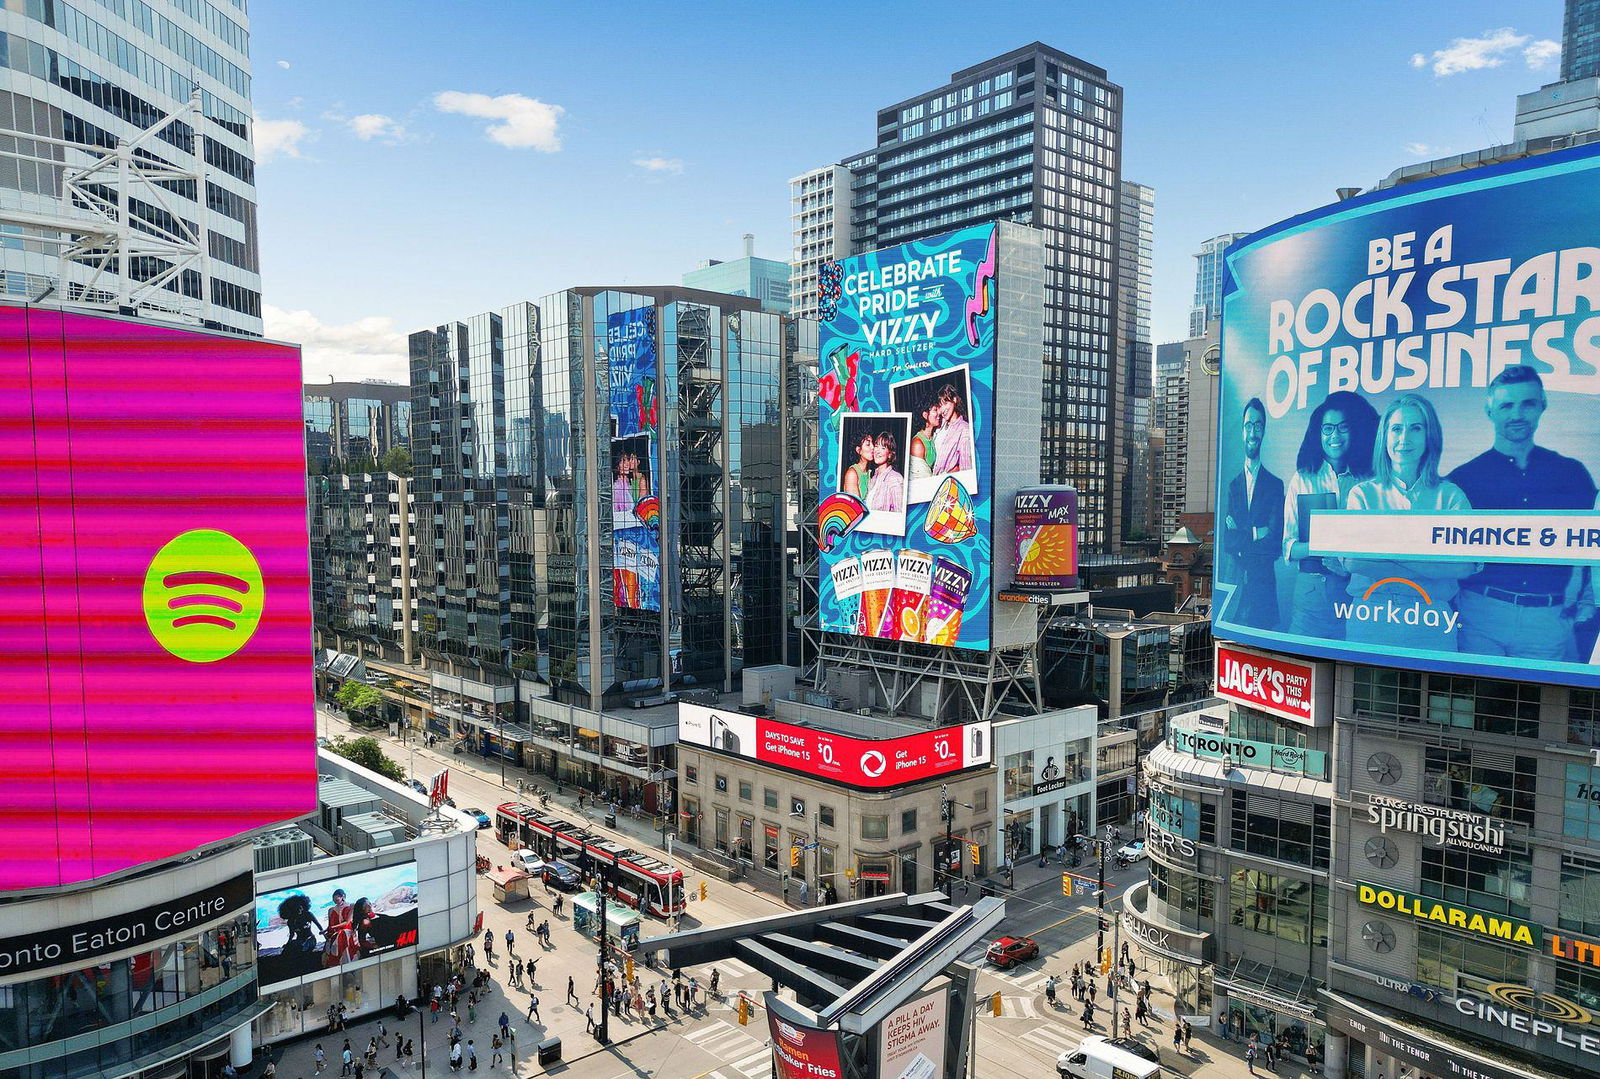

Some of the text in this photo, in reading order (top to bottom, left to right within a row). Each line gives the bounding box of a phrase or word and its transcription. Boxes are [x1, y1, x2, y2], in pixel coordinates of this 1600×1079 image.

[1367, 224, 1453, 275] BE A
[844, 249, 962, 295] CELEBRATE
[859, 285, 920, 318] PRIDE
[1268, 246, 1600, 355] ROCK STAR
[861, 310, 941, 347] VIZZY
[869, 342, 934, 358] HARD SELTZER
[1266, 349, 1322, 419] OF
[1048, 505, 1069, 520] MAX
[1432, 526, 1532, 546] FINANCE
[1539, 527, 1558, 547] &
[833, 563, 859, 582] VIZZY
[862, 557, 893, 572] VIZZY
[899, 558, 932, 575] VIZZY
[935, 565, 970, 592] VIZZY
[1220, 659, 1284, 704] JACK'S
[1285, 673, 1308, 687] PARTY
[1286, 685, 1302, 697] THIS
[1285, 696, 1302, 709] WAY
[765, 731, 805, 746] DAYS TO SAVE
[1182, 732, 1256, 758] TORONTO
[765, 742, 811, 761] Get iPhone 15
[896, 750, 908, 759] Get
[896, 758, 917, 770] iPhone
[918, 756, 927, 765] 15
[1037, 781, 1065, 794] Foot Locker
[1368, 794, 1482, 825] LOUNGE RESTAURANT
[71, 922, 146, 954] Eaton
[155, 896, 226, 932] Centre
[1359, 885, 1534, 945] DOLLARAMA
[1129, 914, 1170, 950] SHACK
[1376, 976, 1409, 993] ULTRA
[887, 1015, 926, 1039] KEEPS HIV
[888, 1001, 934, 1029] A PILL A DAY
[1349, 1018, 1366, 1033] ENOR
[1456, 998, 1600, 1056] CINEPLE
[887, 1019, 940, 1050] STIGMA AWAY.
[1391, 1038, 1430, 1062] THE TENOR
[807, 1063, 836, 1078] Fries
